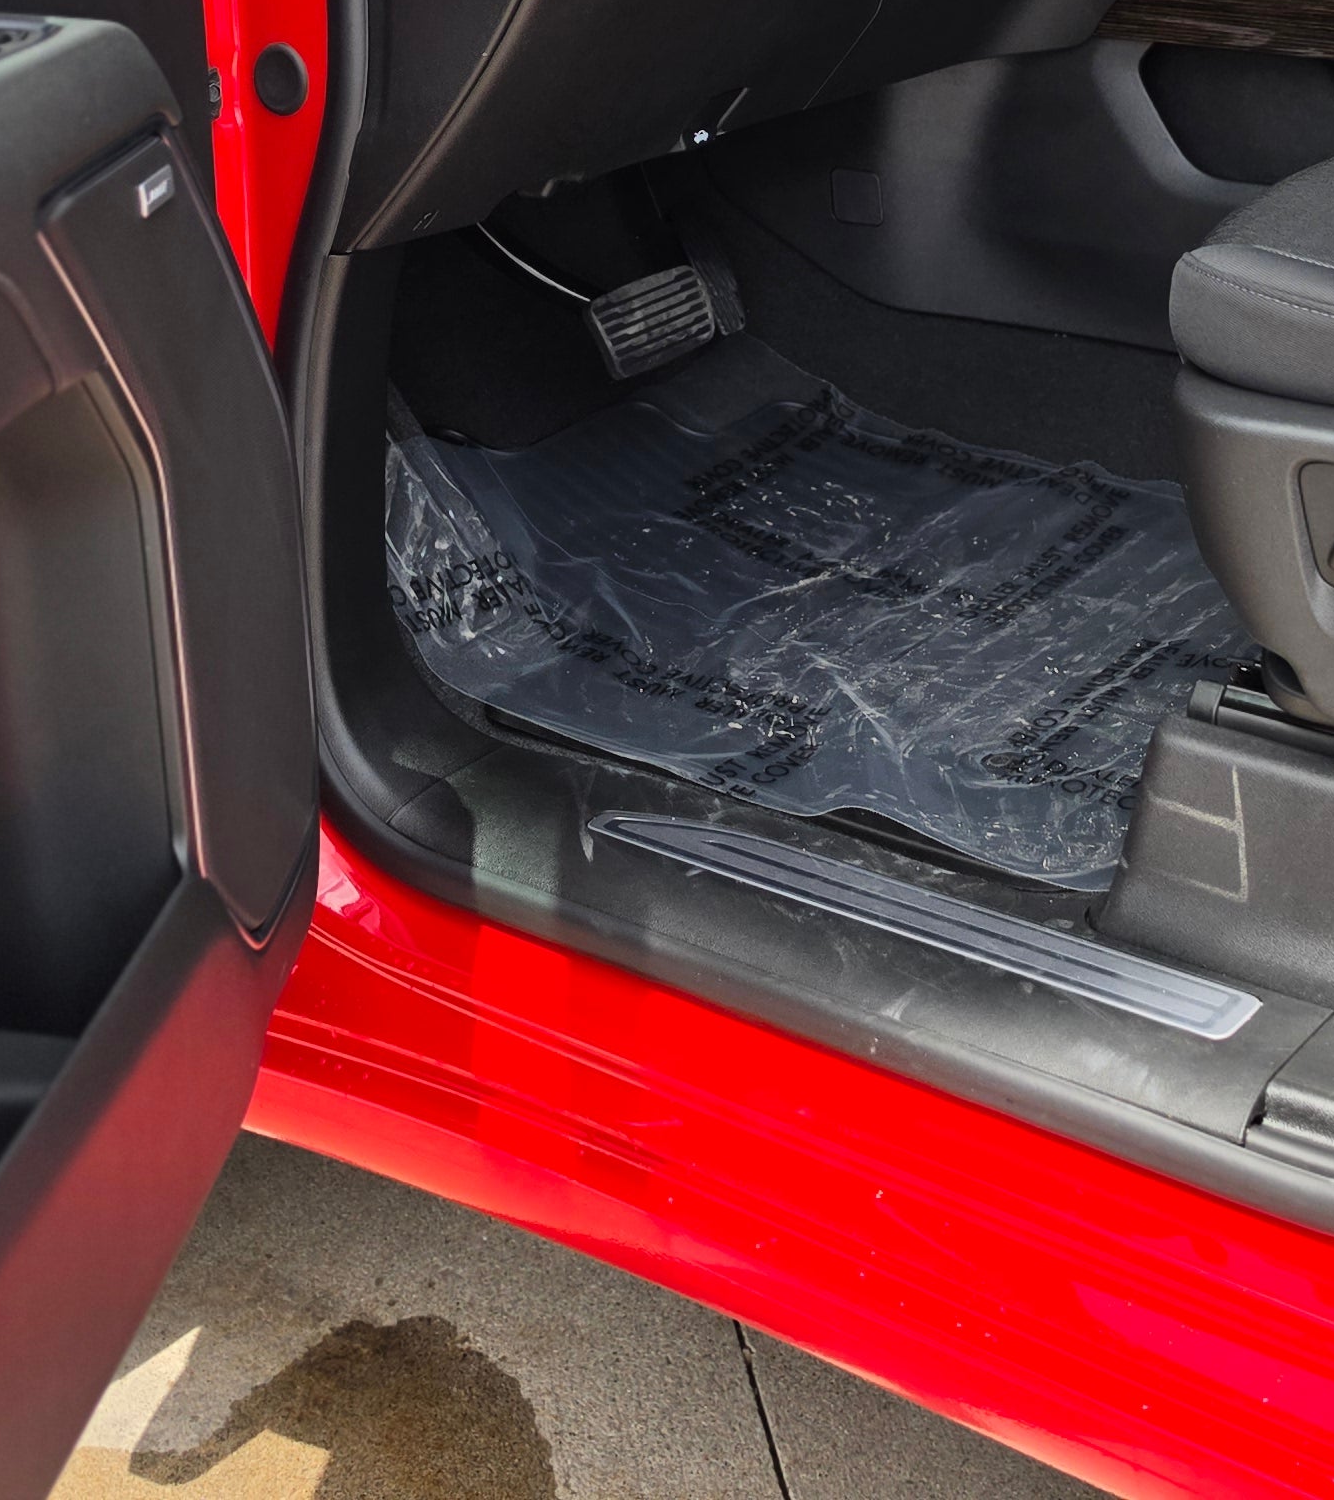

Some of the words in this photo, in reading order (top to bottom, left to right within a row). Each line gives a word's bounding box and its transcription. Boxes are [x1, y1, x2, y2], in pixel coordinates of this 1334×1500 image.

[1062, 486, 1132, 545] REMOVE
[1073, 524, 1130, 565] COVER
[472, 575, 527, 613] ALER
[698, 756, 748, 787] UST
